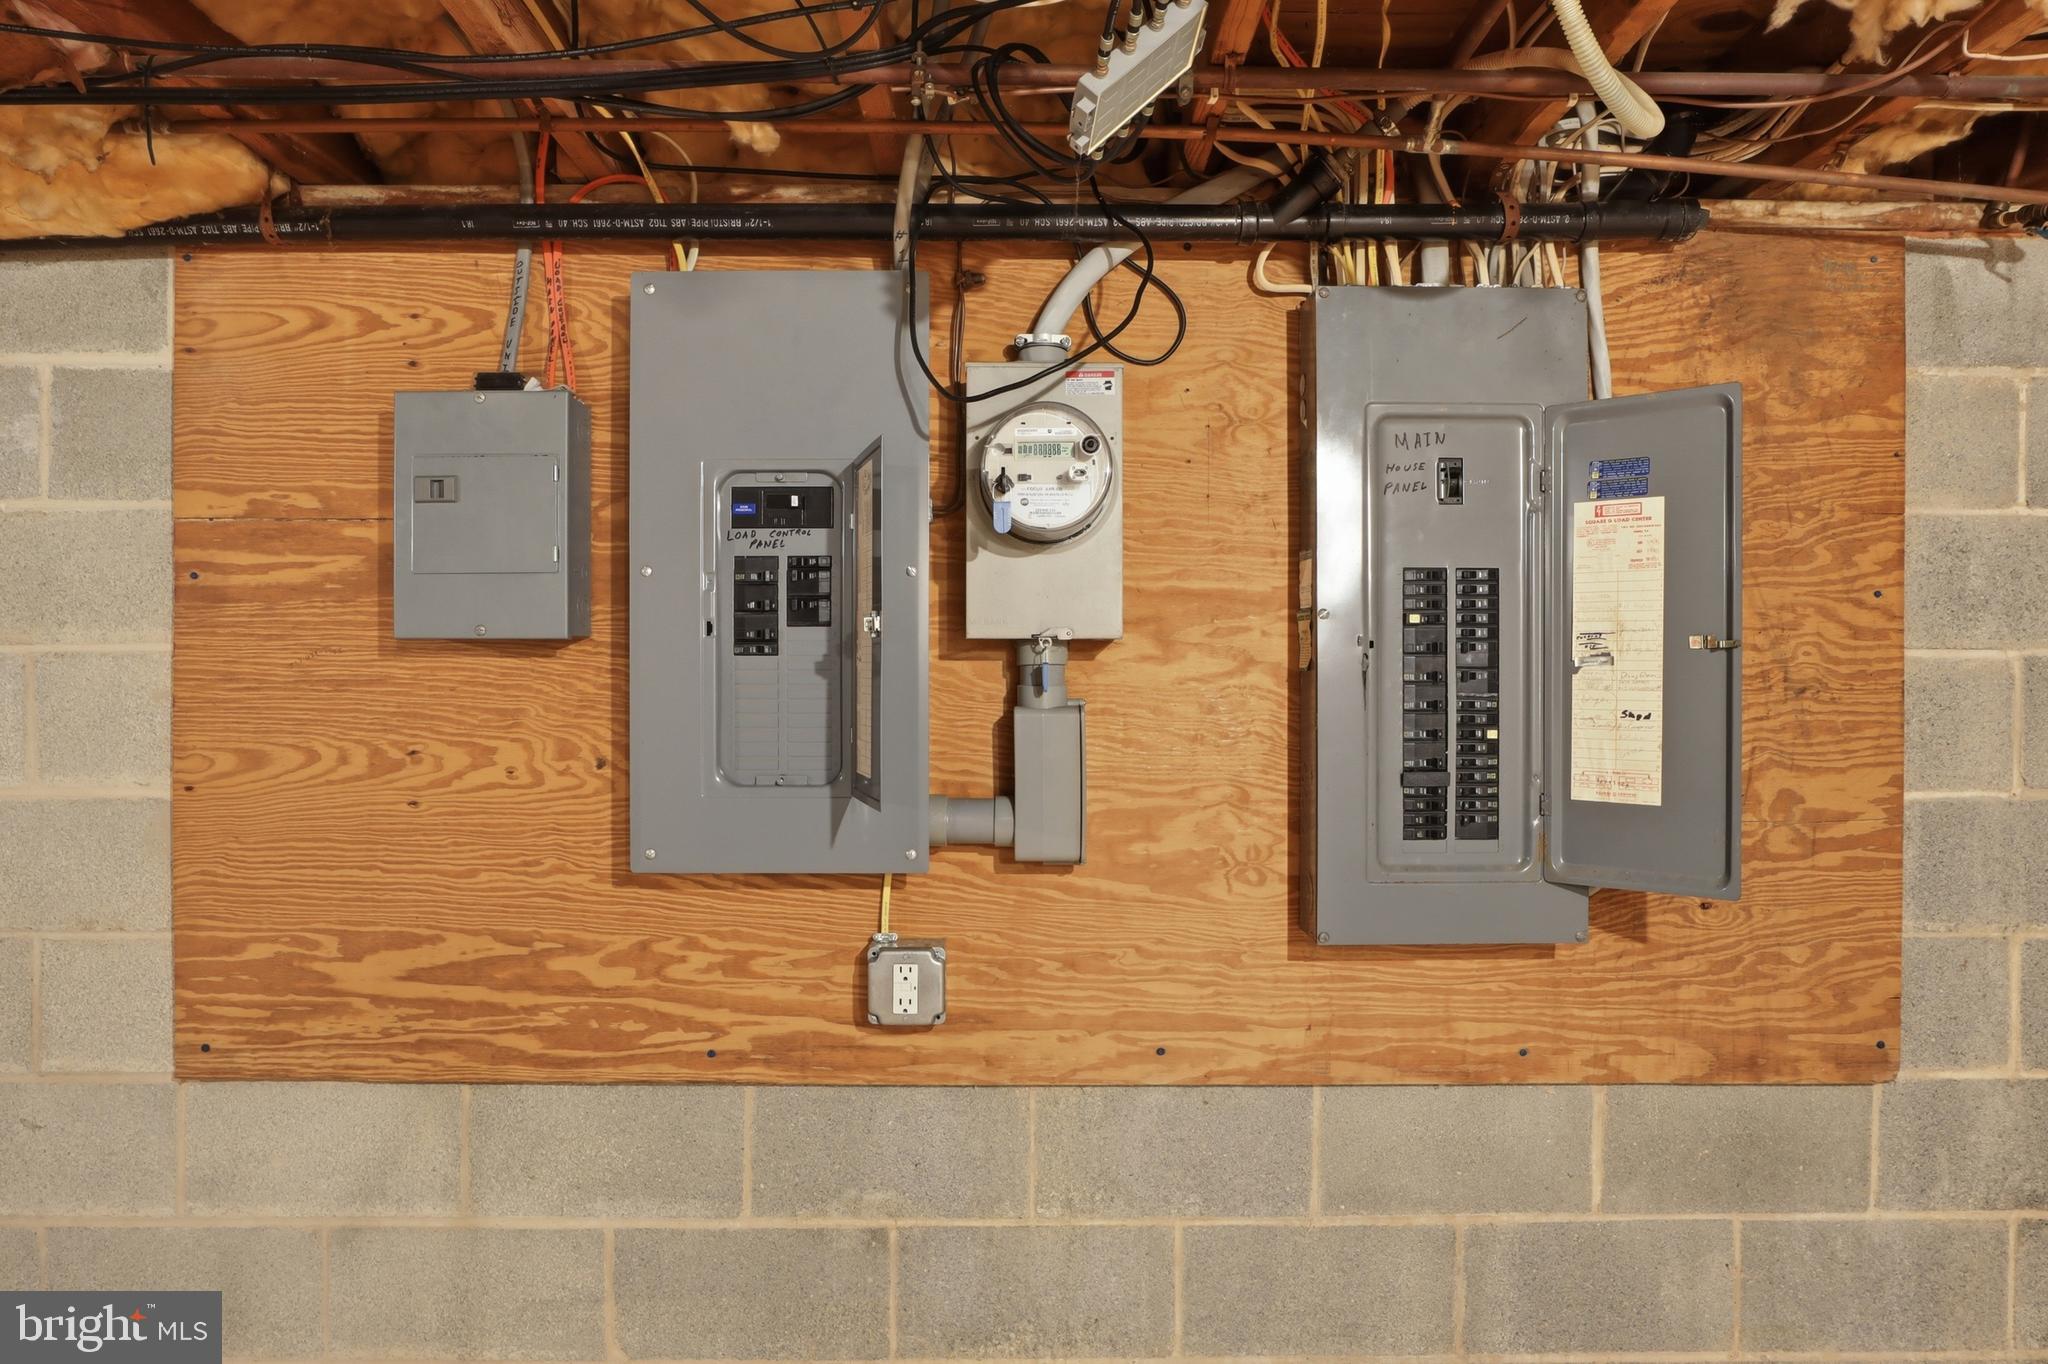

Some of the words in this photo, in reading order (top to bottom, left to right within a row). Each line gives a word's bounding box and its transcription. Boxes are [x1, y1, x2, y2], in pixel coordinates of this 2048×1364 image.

[1395, 432, 1446, 450] MAIN
[1386, 462, 1426, 474] HOUSE
[1384, 481, 1427, 495] PANEL
[727, 530, 757, 541] LOAD
[769, 528, 812, 538] CONTROL
[749, 539, 785, 549] PANEL
